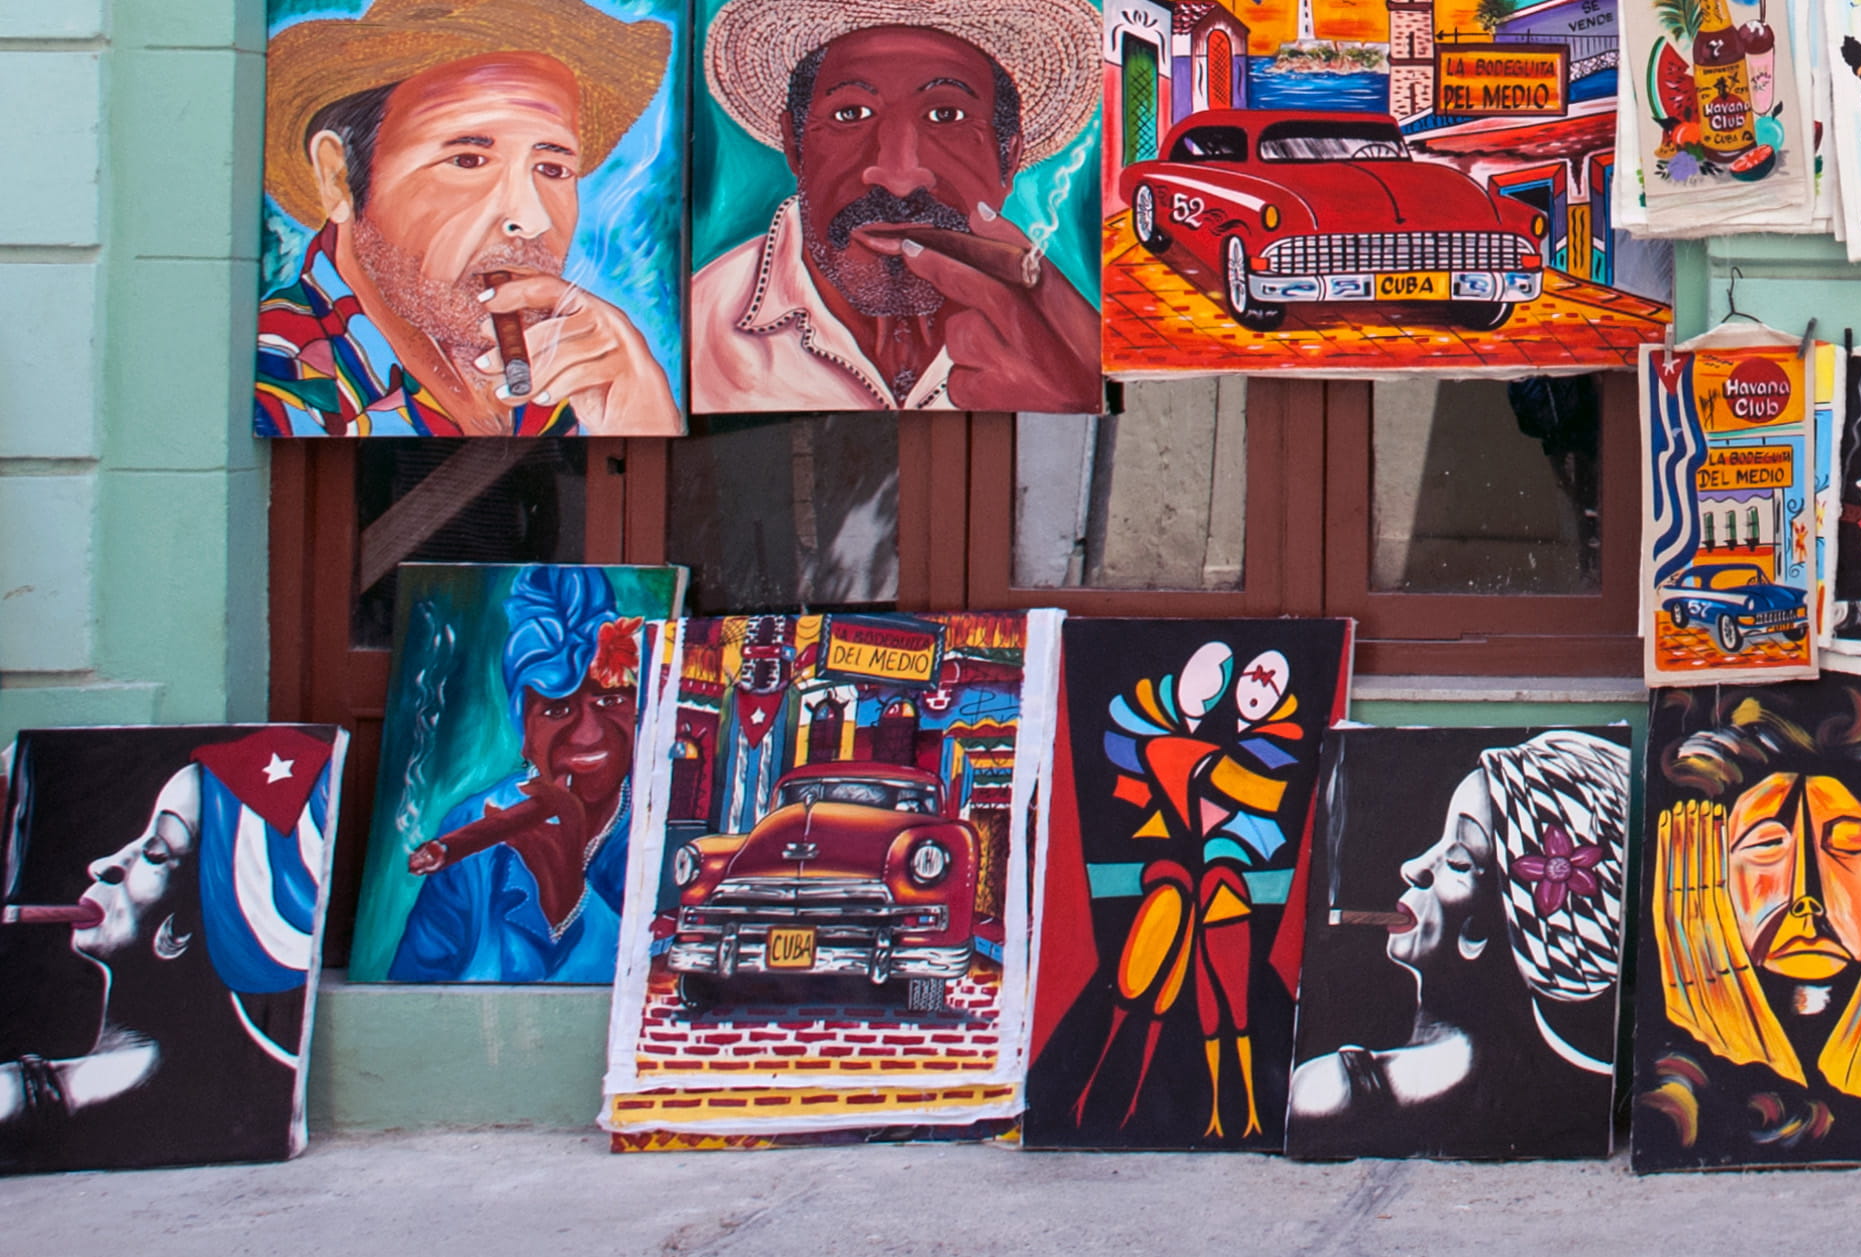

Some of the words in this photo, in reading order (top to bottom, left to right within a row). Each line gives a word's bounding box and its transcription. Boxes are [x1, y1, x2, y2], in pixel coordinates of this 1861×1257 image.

[1581, 0, 1600, 15] SE
[1568, 12, 1614, 33] VENDE
[1446, 57, 1465, 77] LA
[1475, 58, 1556, 78] BODEGUITA
[1482, 83, 1549, 110] MEDIO
[1711, 114, 1745, 130] Club
[1171, 193, 1205, 229] 52
[1381, 276, 1434, 296] CUBA
[1725, 378, 1790, 398] Havana
[1734, 397, 1779, 418] Club
[1708, 452, 1726, 466] LA
[1697, 470, 1730, 489] DEL
[1736, 467, 1785, 485] MEDIO
[1688, 599, 1713, 619] 57
[868, 647, 929, 674] MEDIO
[772, 934, 812, 961] CUBA
